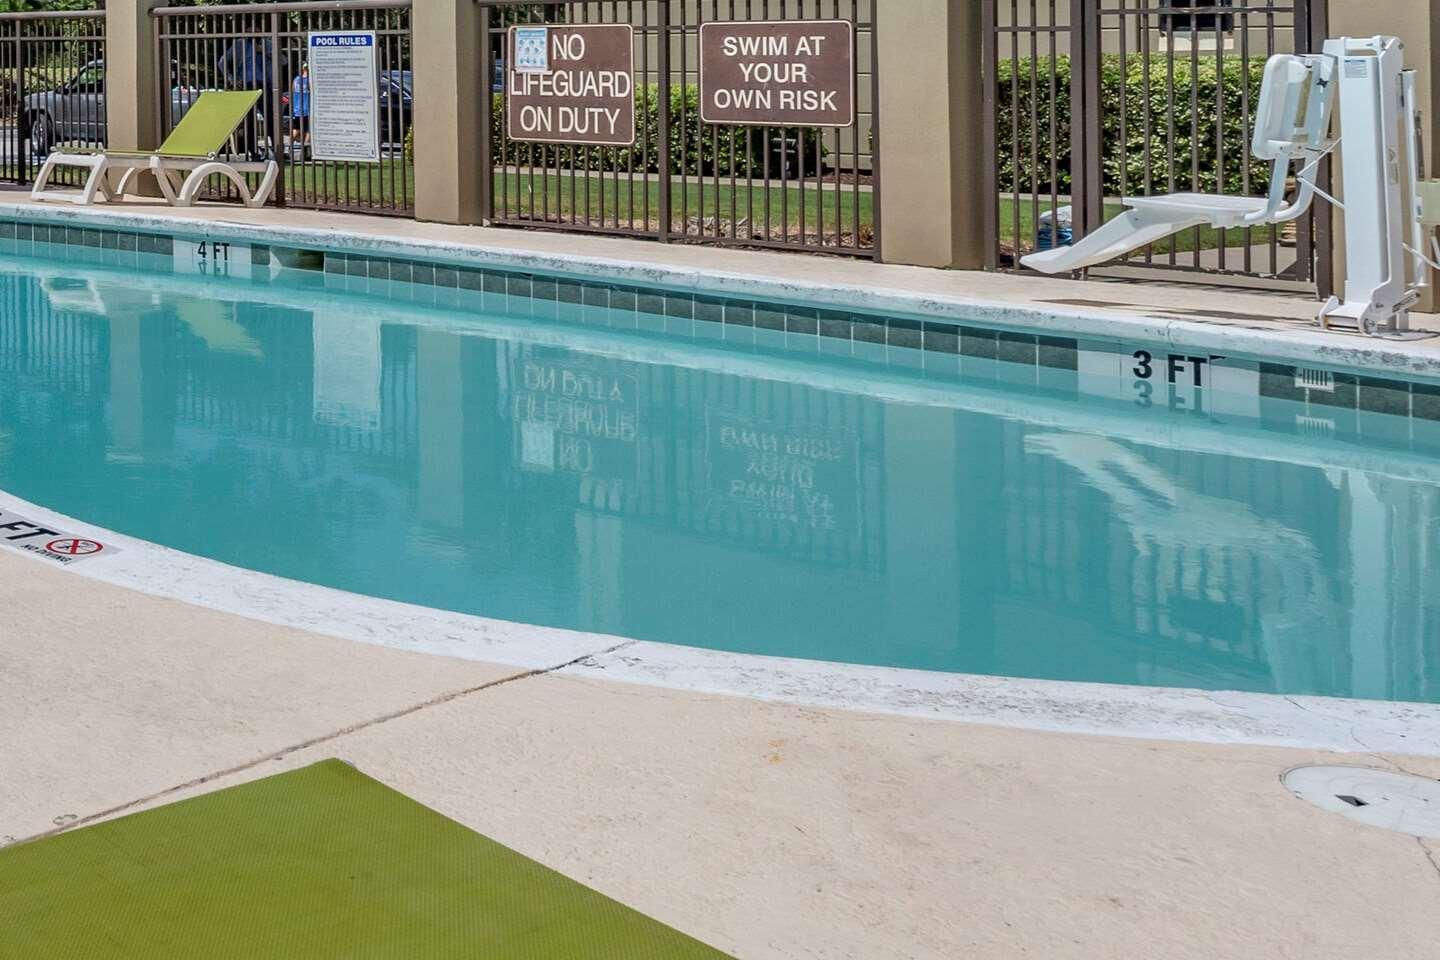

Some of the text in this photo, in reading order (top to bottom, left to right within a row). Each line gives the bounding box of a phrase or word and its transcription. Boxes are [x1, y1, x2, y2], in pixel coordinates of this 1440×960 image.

[316, 37, 367, 46] POOL RULES
[552, 34, 585, 61] NO
[723, 36, 826, 57] SWIM AT
[511, 70, 631, 98] LIFEGUARD
[739, 63, 807, 83] YOUR
[714, 89, 838, 111] OWN RISK
[520, 105, 620, 134] ON DUTY
[198, 241, 230, 260] 4 FT
[1133, 350, 1208, 387] 3 FT
